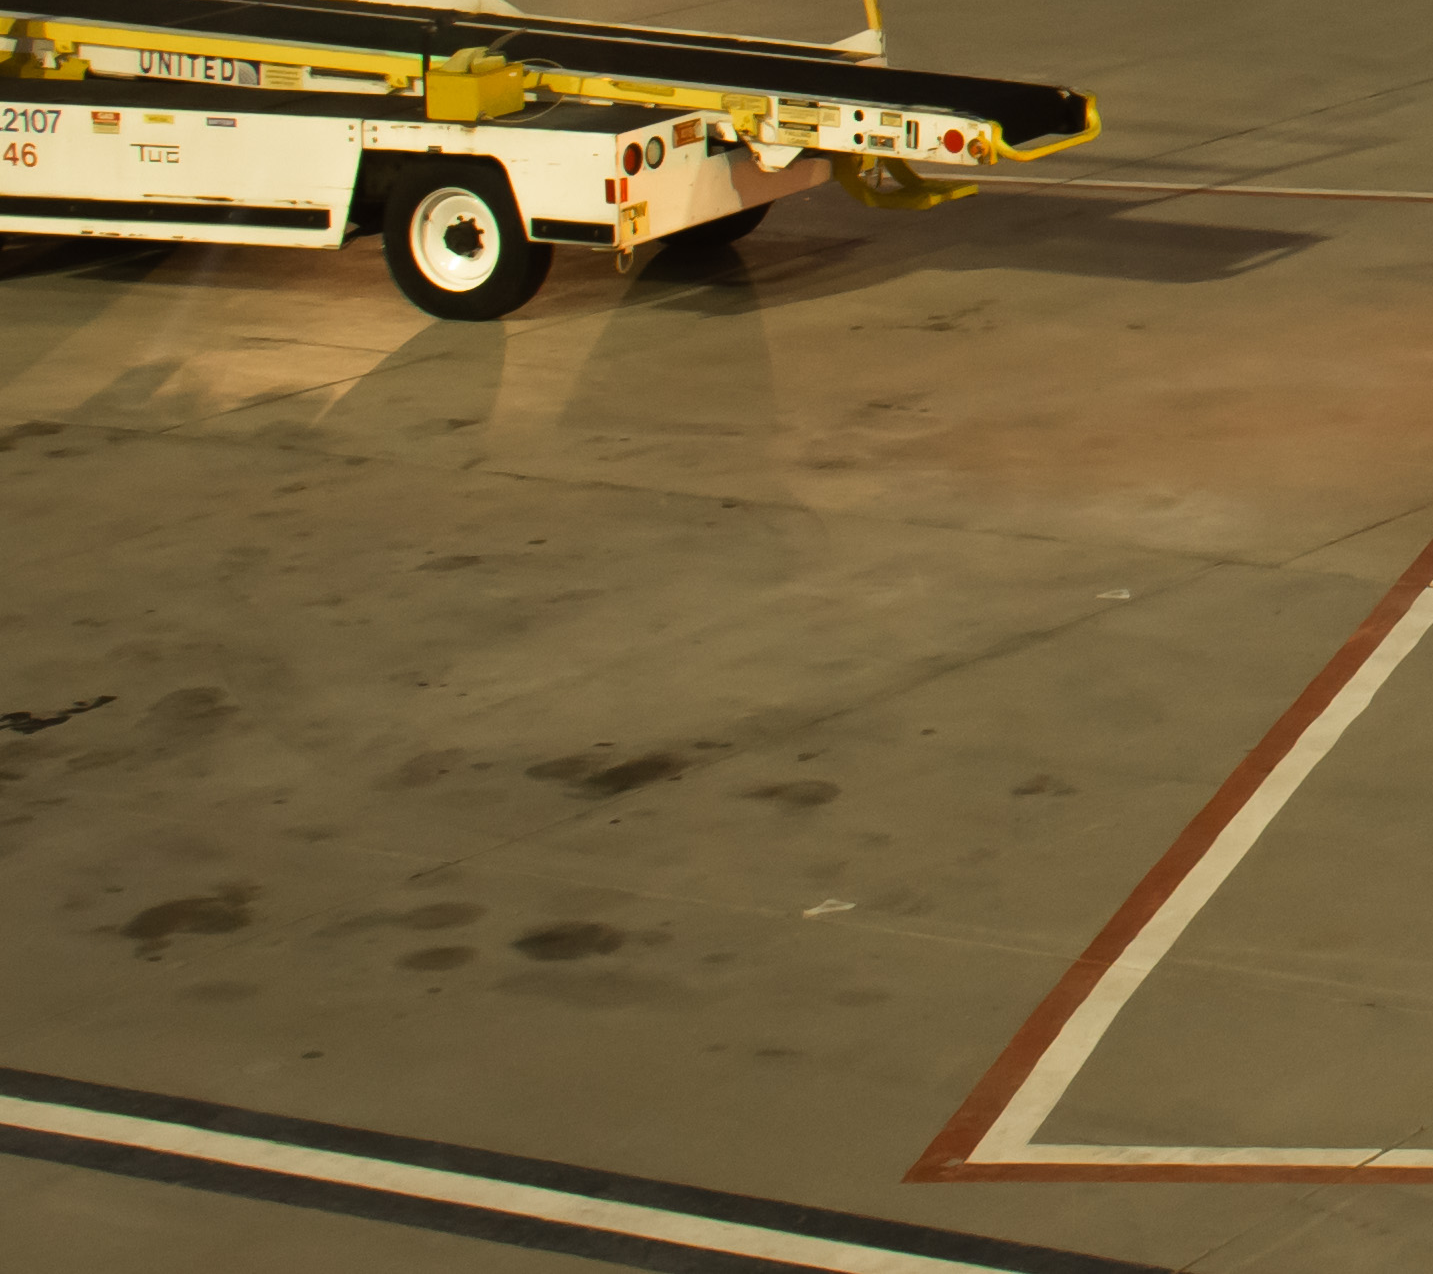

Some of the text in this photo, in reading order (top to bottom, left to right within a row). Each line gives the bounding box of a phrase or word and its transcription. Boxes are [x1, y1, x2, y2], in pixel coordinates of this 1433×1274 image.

[139, 50, 235, 81] UNITED
[0, 108, 62, 134] 2107
[3, 142, 38, 167] 46
